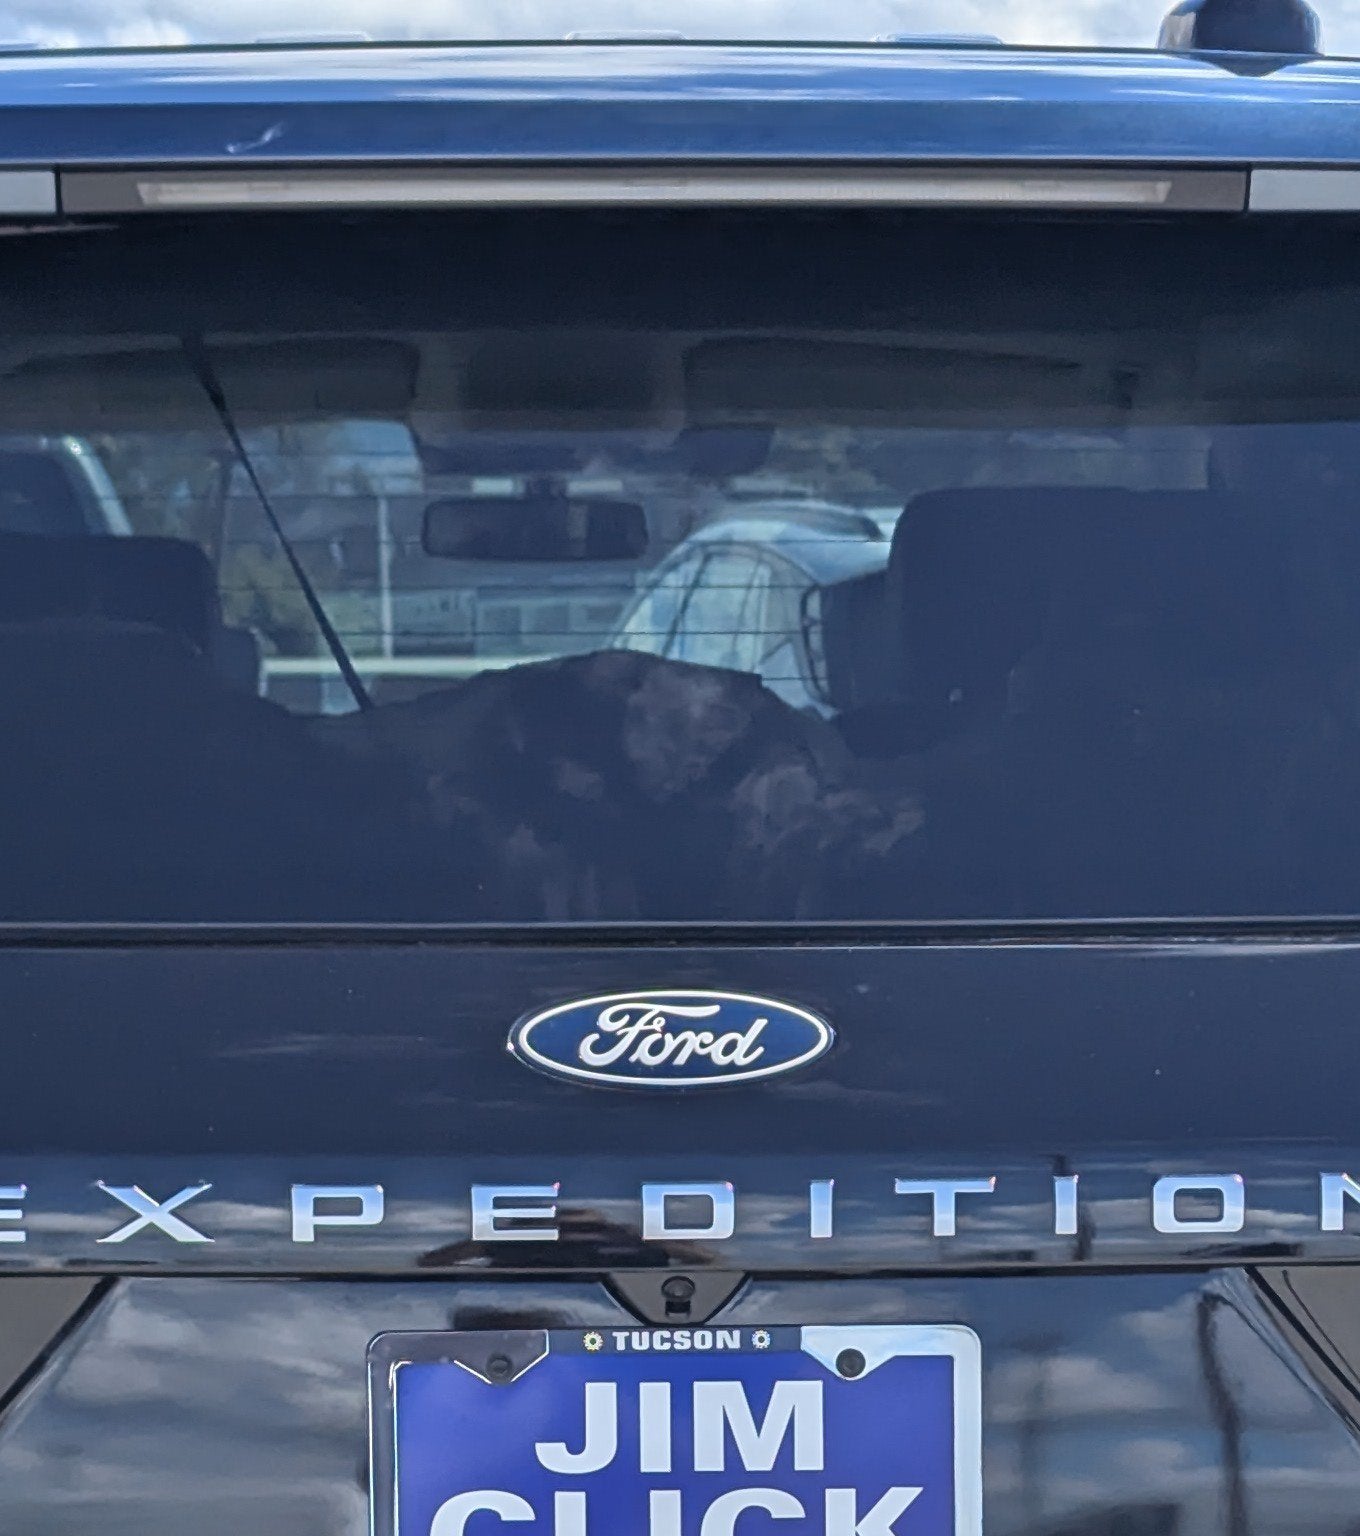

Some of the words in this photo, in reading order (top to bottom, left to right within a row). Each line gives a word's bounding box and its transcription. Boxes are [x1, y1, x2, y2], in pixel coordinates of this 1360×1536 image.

[579, 1003, 768, 1066] Ford
[612, 1329, 741, 1352] TUCSON
[535, 1380, 824, 1474] JIM
